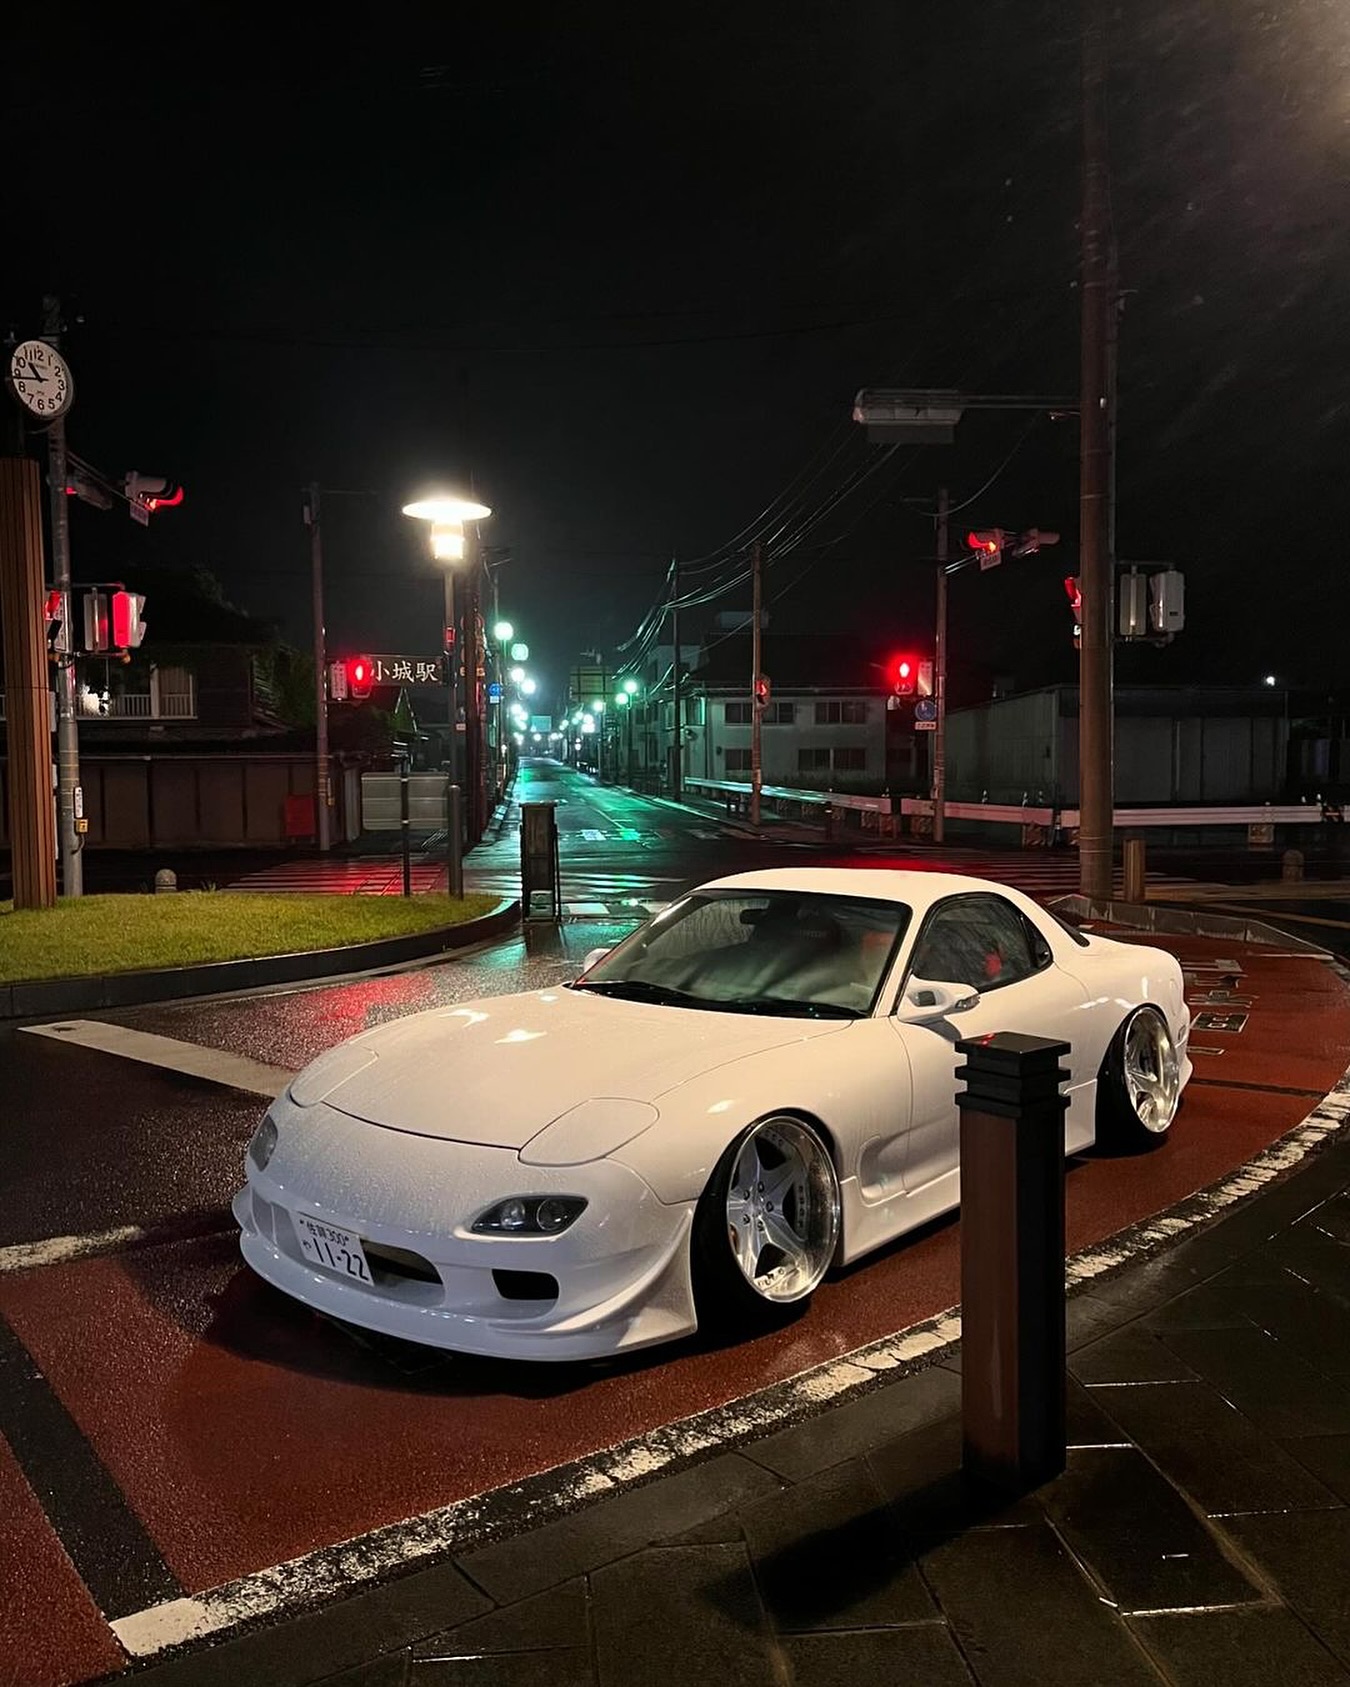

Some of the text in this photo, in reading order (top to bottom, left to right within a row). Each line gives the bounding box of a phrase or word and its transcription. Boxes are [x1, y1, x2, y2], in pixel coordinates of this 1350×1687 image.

[33, 348, 44, 362] 12
[47, 355, 51, 367] 1
[16, 356, 26, 369] 10
[14, 368, 21, 378] 9
[54, 365, 61, 377] 2
[18, 381, 26, 393] 8
[58, 379, 65, 391] 3
[27, 393, 35, 404] 7
[55, 391, 62, 402] 4
[37, 399, 45, 410] 6
[47, 398, 55, 410] 5
[370, 660, 439, 683] 小城駅
